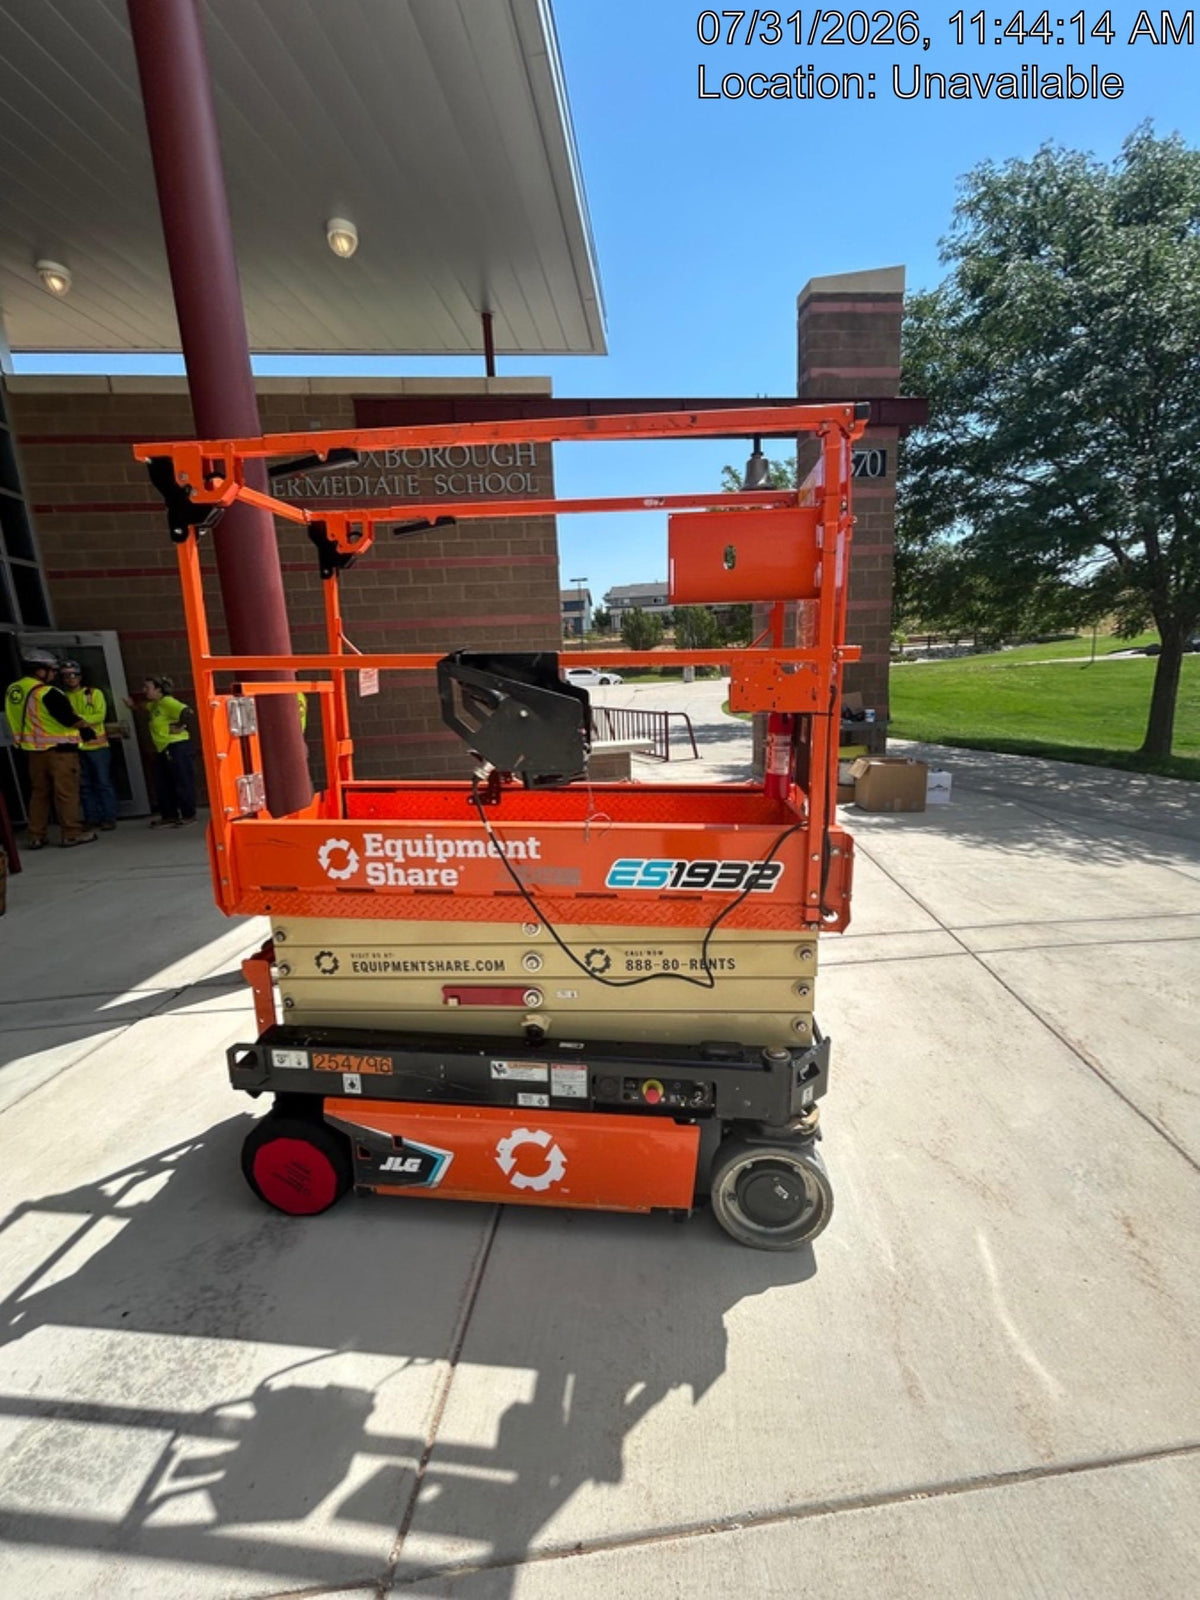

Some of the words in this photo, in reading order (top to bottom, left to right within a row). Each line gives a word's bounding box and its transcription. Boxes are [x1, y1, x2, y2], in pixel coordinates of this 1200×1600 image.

[433, 472, 539, 496] SCHOOL
[363, 833, 541, 863] Equipment
[366, 862, 459, 887] Share
[605, 858, 784, 892] ES1932
[352, 959, 505, 973] EQUIPMENTSHARE.COM
[625, 957, 736, 971] 888-80-RENTS
[313, 1053, 393, 1074] 254796
[379, 1156, 422, 1173] JLG
